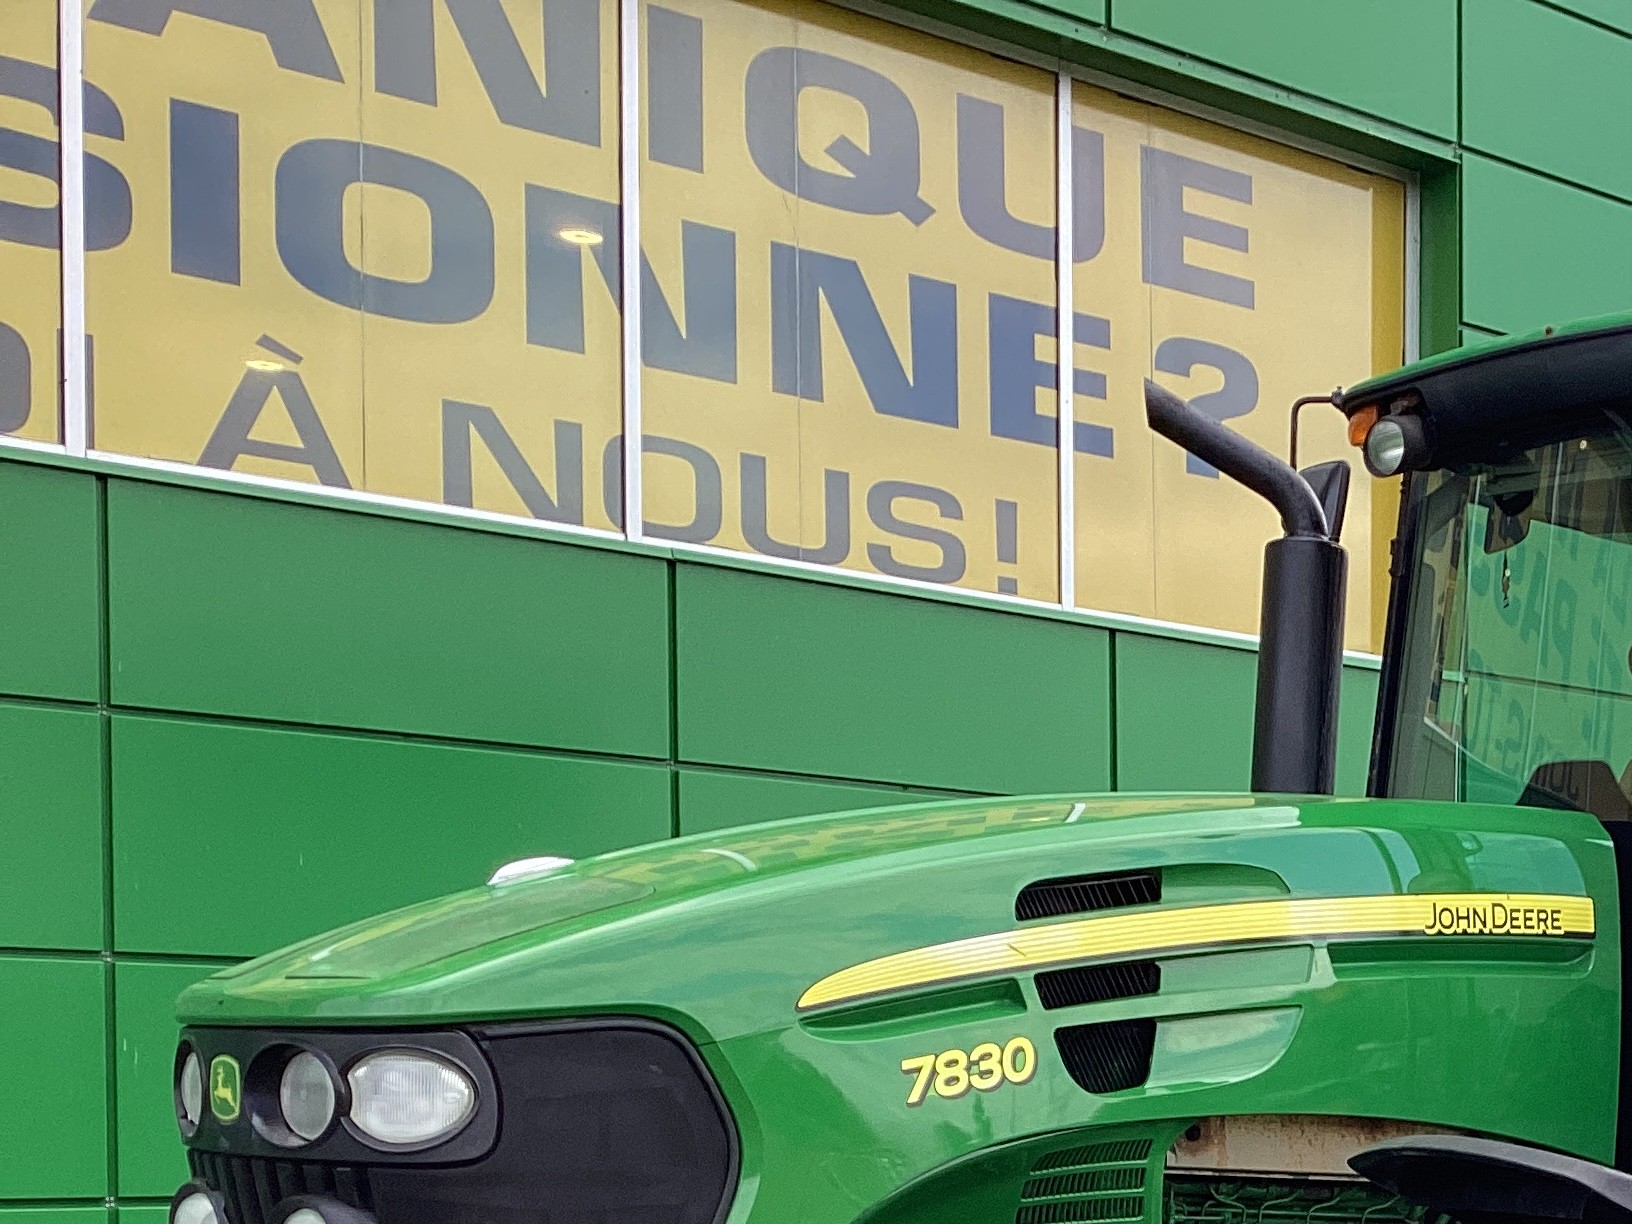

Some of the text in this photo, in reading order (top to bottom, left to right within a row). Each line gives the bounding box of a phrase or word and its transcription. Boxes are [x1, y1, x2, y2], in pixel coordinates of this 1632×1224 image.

[1424, 902, 1563, 931] JOHN DEERE
[901, 1036, 1038, 1107] 7830
